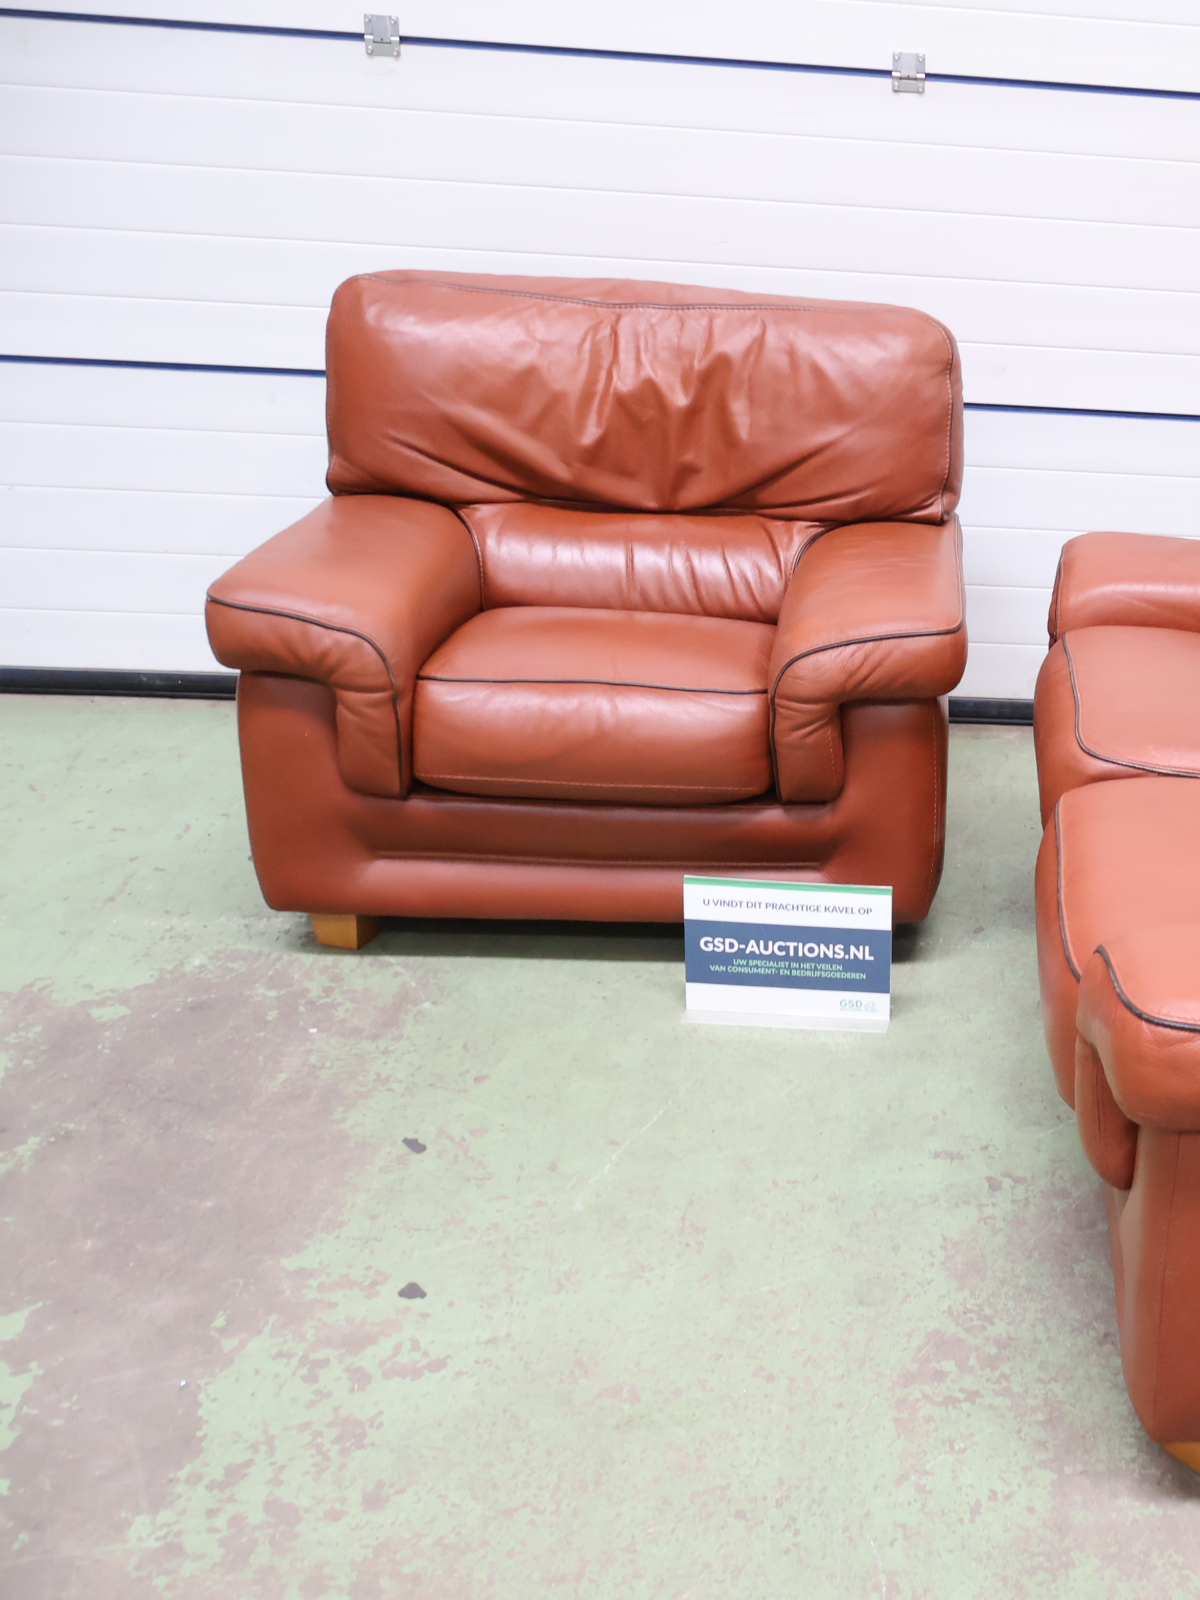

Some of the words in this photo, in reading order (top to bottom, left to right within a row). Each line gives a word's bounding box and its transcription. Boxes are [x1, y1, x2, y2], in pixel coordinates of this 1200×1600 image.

[702, 898, 711, 907] U
[712, 899, 744, 909] VINDT
[746, 901, 763, 910] DIT
[765, 902, 822, 914] PRACHTIGE
[824, 905, 856, 915] KAVEL
[857, 907, 873, 916] OP
[699, 936, 875, 961] GSD-AUCTIONS.NL
[709, 964, 726, 973] VAN
[727, 965, 778, 975] CONSUMENT-
[780, 968, 790, 976] EN
[791, 968, 867, 980] BEDRIJFSGOEDEREN
[733, 958, 747, 967] UW
[748, 959, 790, 969] SPECIALIST
[790, 961, 799, 969] IN
[801, 962, 815, 970] HET
[816, 963, 843, 972] VEILEN
[839, 999, 863, 1009] GSD
